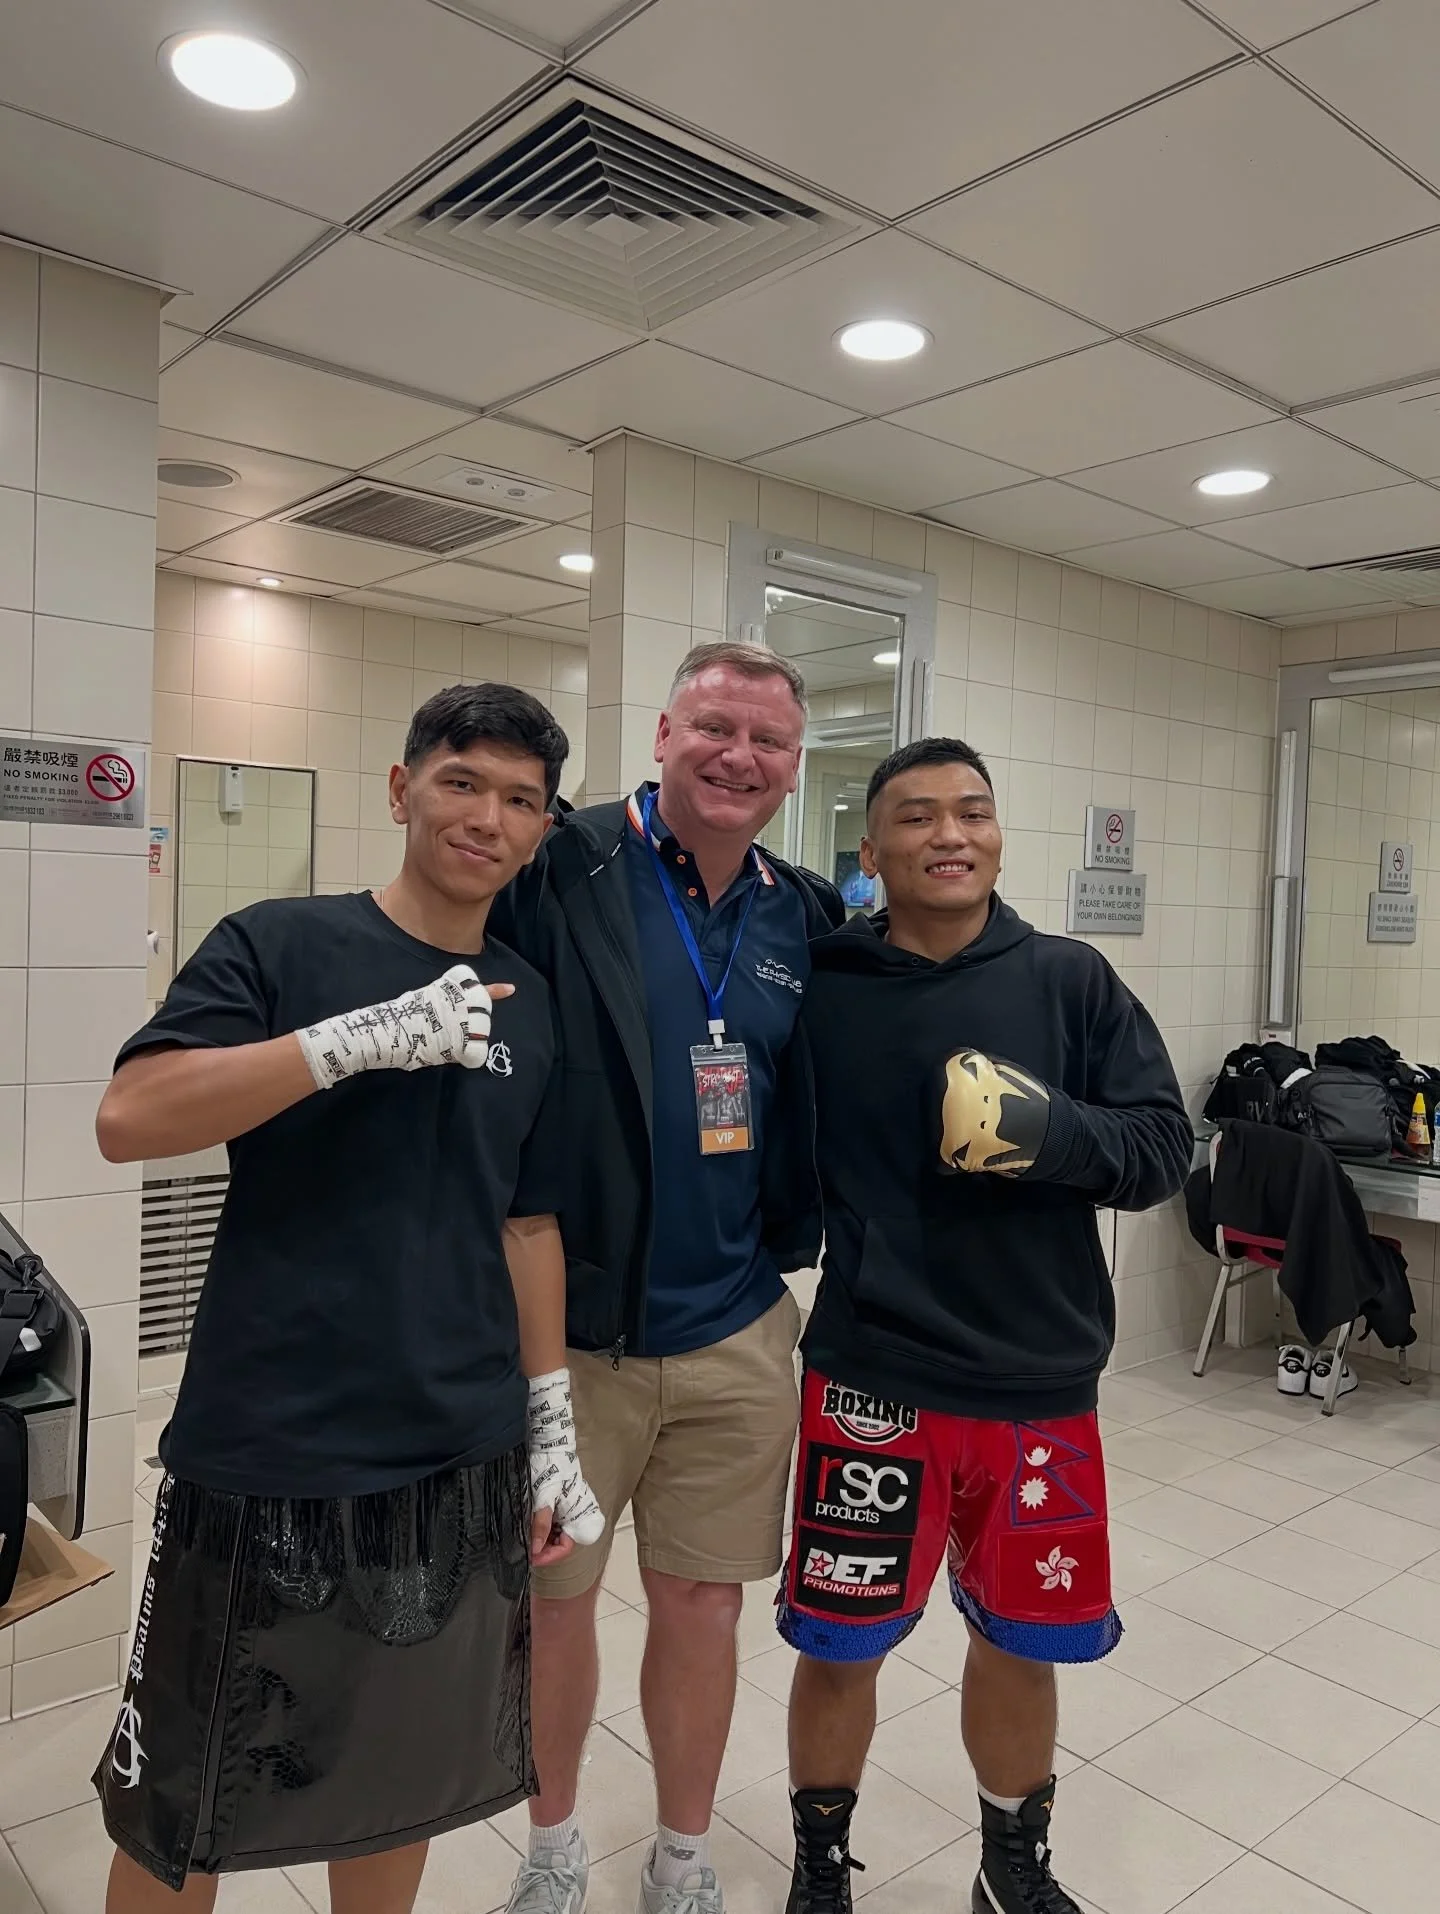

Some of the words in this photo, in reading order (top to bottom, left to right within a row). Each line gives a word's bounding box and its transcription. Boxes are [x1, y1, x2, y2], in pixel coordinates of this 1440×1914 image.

[4, 747, 79, 768] 嚴禁吸煙
[3, 769, 20, 778] NO
[24, 770, 79, 783] SMOKING
[1095, 855, 1103, 863] NO
[1104, 856, 1130, 865] SMOKING
[1079, 899, 1100, 908] PLEASE
[1102, 900, 1116, 909] TAKE
[1117, 901, 1132, 909] CARE
[1077, 912, 1092, 920] YOUR
[1093, 912, 1107, 921] OWN
[1107, 912, 1142, 922] BELONGINGS
[715, 1131, 735, 1145] VIP
[822, 1385, 918, 1432] BOXING
[856, 1420, 868, 1429] SINCE
[815, 1502, 880, 1524] products
[803, 1547, 898, 1585] DEF
[803, 1577, 899, 1597] PROMOTIONS
[129, 1572, 155, 1686] Psalms
